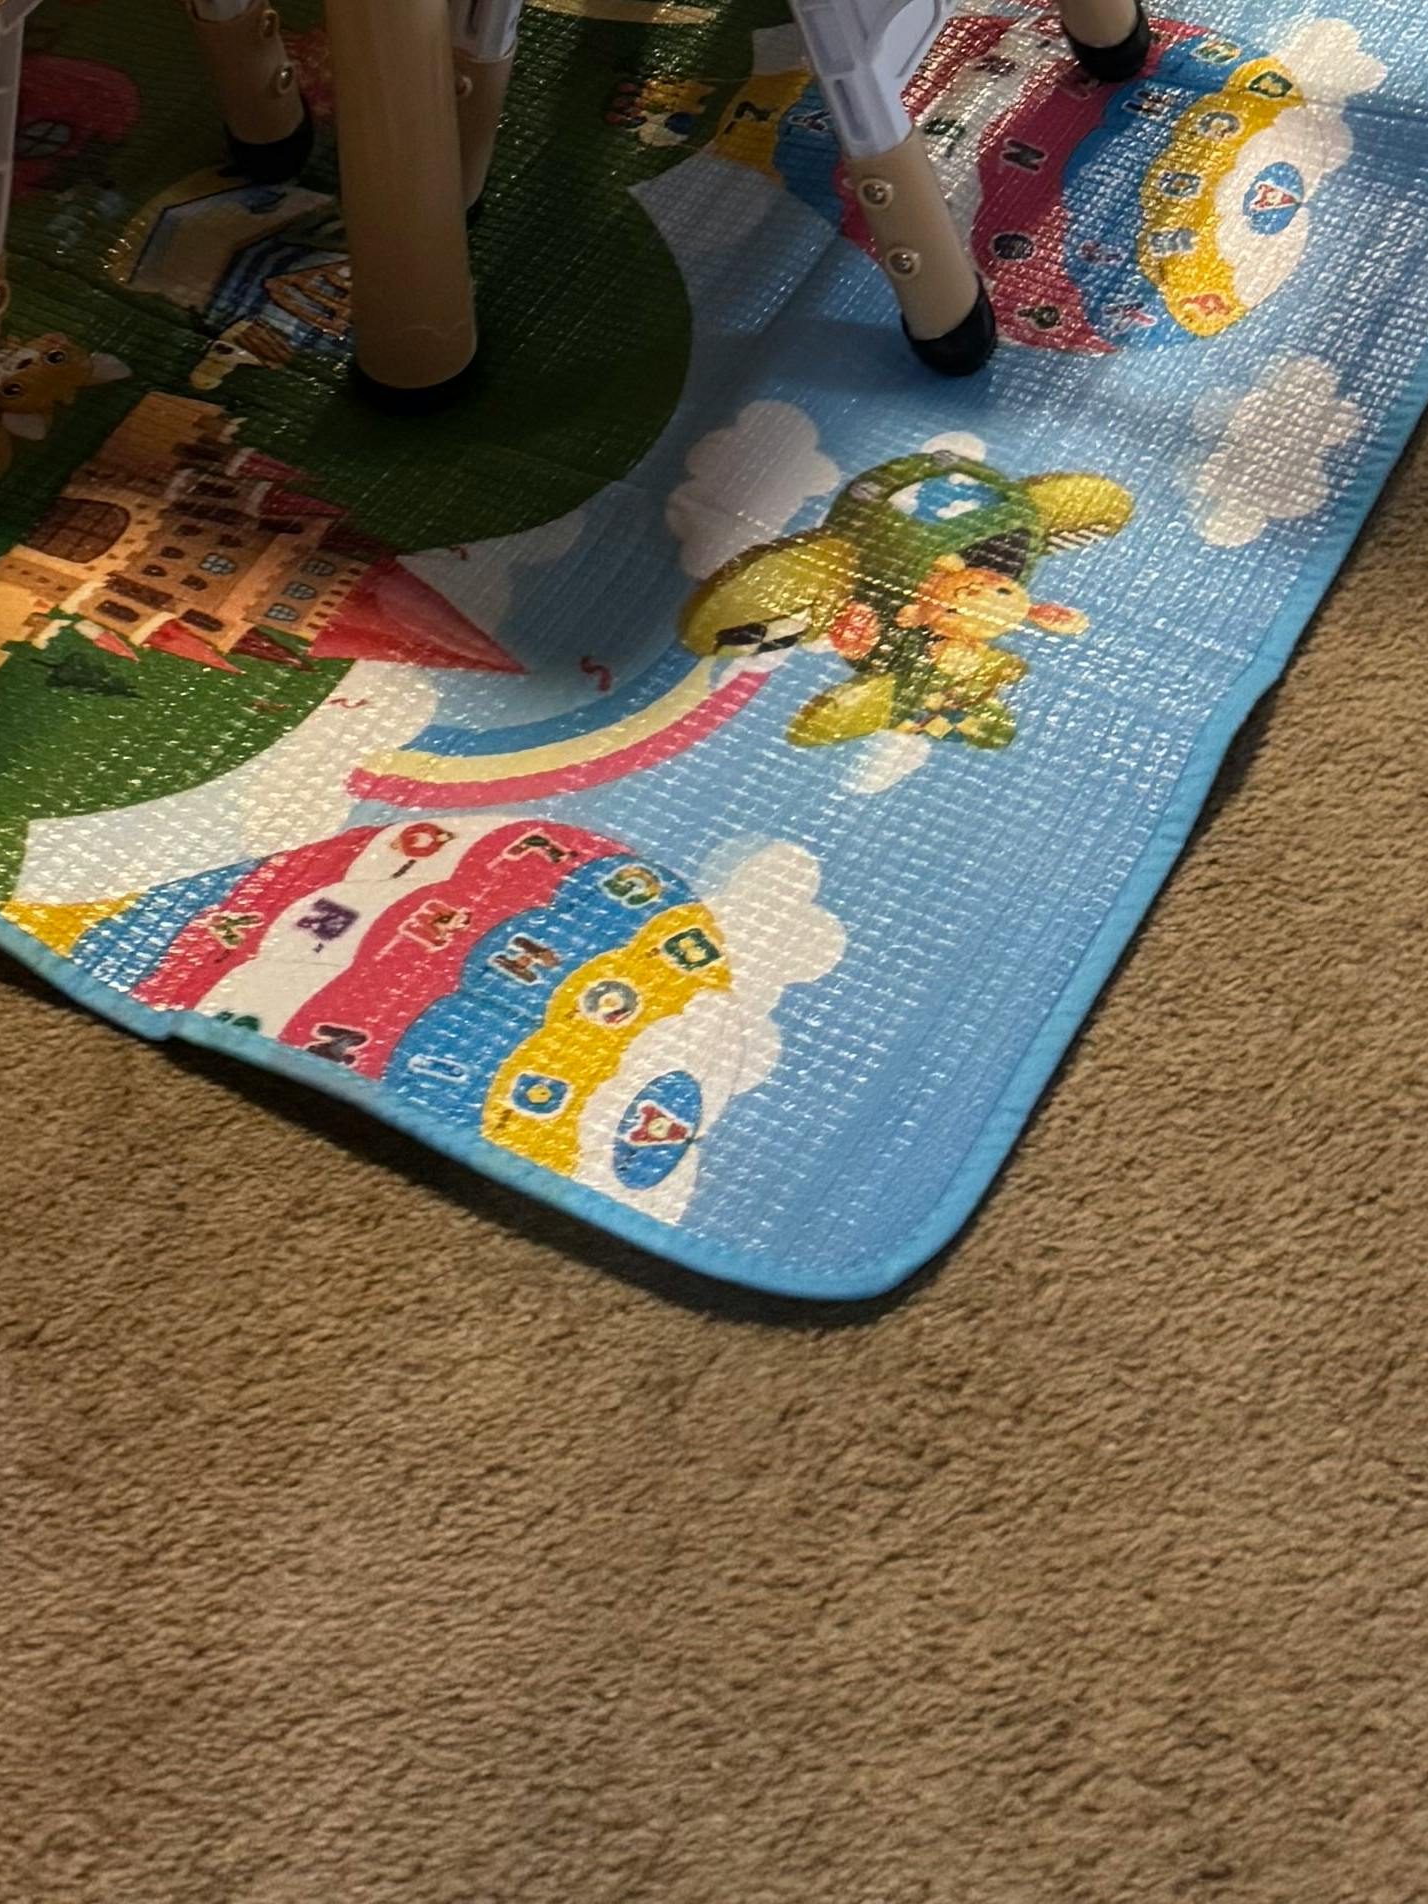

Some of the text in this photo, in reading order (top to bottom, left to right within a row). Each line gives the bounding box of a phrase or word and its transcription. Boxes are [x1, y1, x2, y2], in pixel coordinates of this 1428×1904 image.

[1249, 71, 1293, 98] B
[1003, 139, 1045, 173] N
[603, 864, 662, 907] G
[298, 899, 358, 940] R
[495, 936, 560, 984] H
[663, 928, 720, 971] B
[582, 979, 640, 1024] C
[307, 1024, 370, 1065] N
[409, 1054, 466, 1081] I
[510, 1072, 569, 1116] D
[625, 1100, 689, 1147] A
